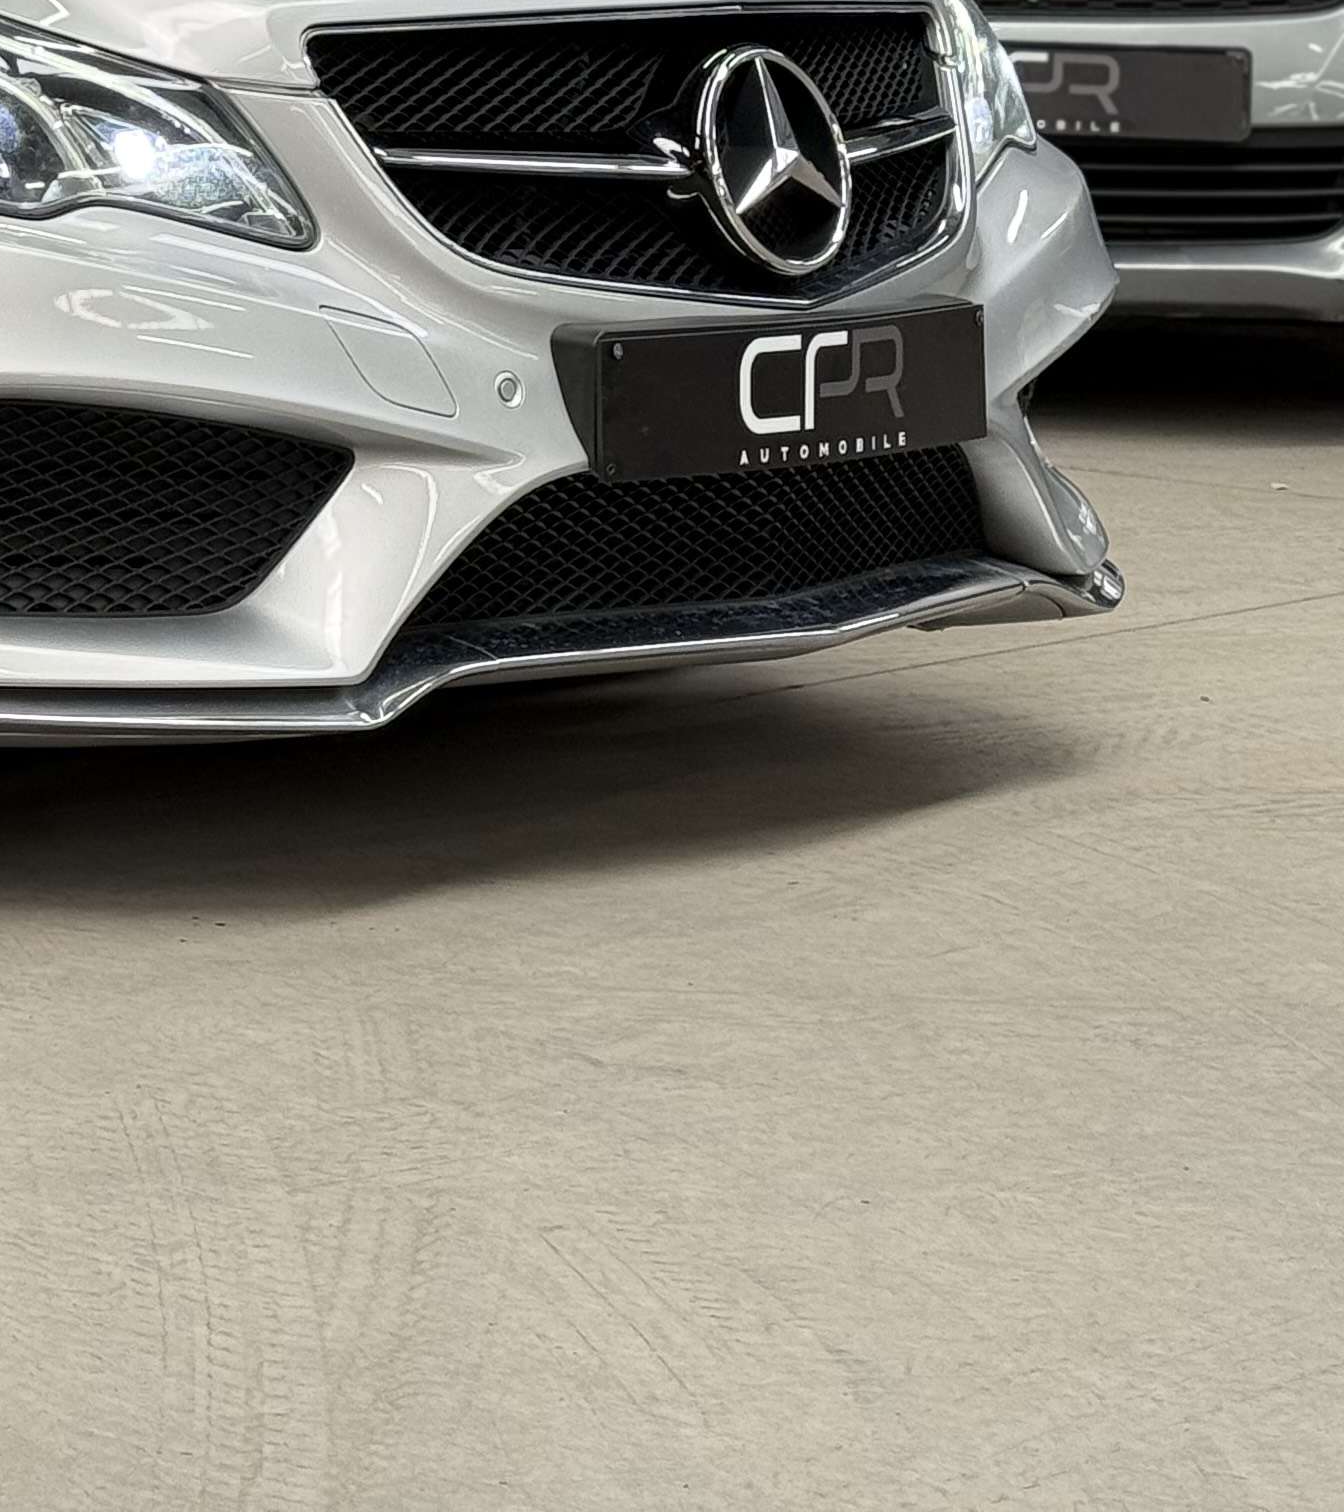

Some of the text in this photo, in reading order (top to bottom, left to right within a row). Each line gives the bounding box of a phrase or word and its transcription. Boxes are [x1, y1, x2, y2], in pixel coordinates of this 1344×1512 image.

[1007, 51, 1120, 115] PR
[739, 324, 905, 435] CPR
[739, 431, 907, 465] AUTOMOBILE
